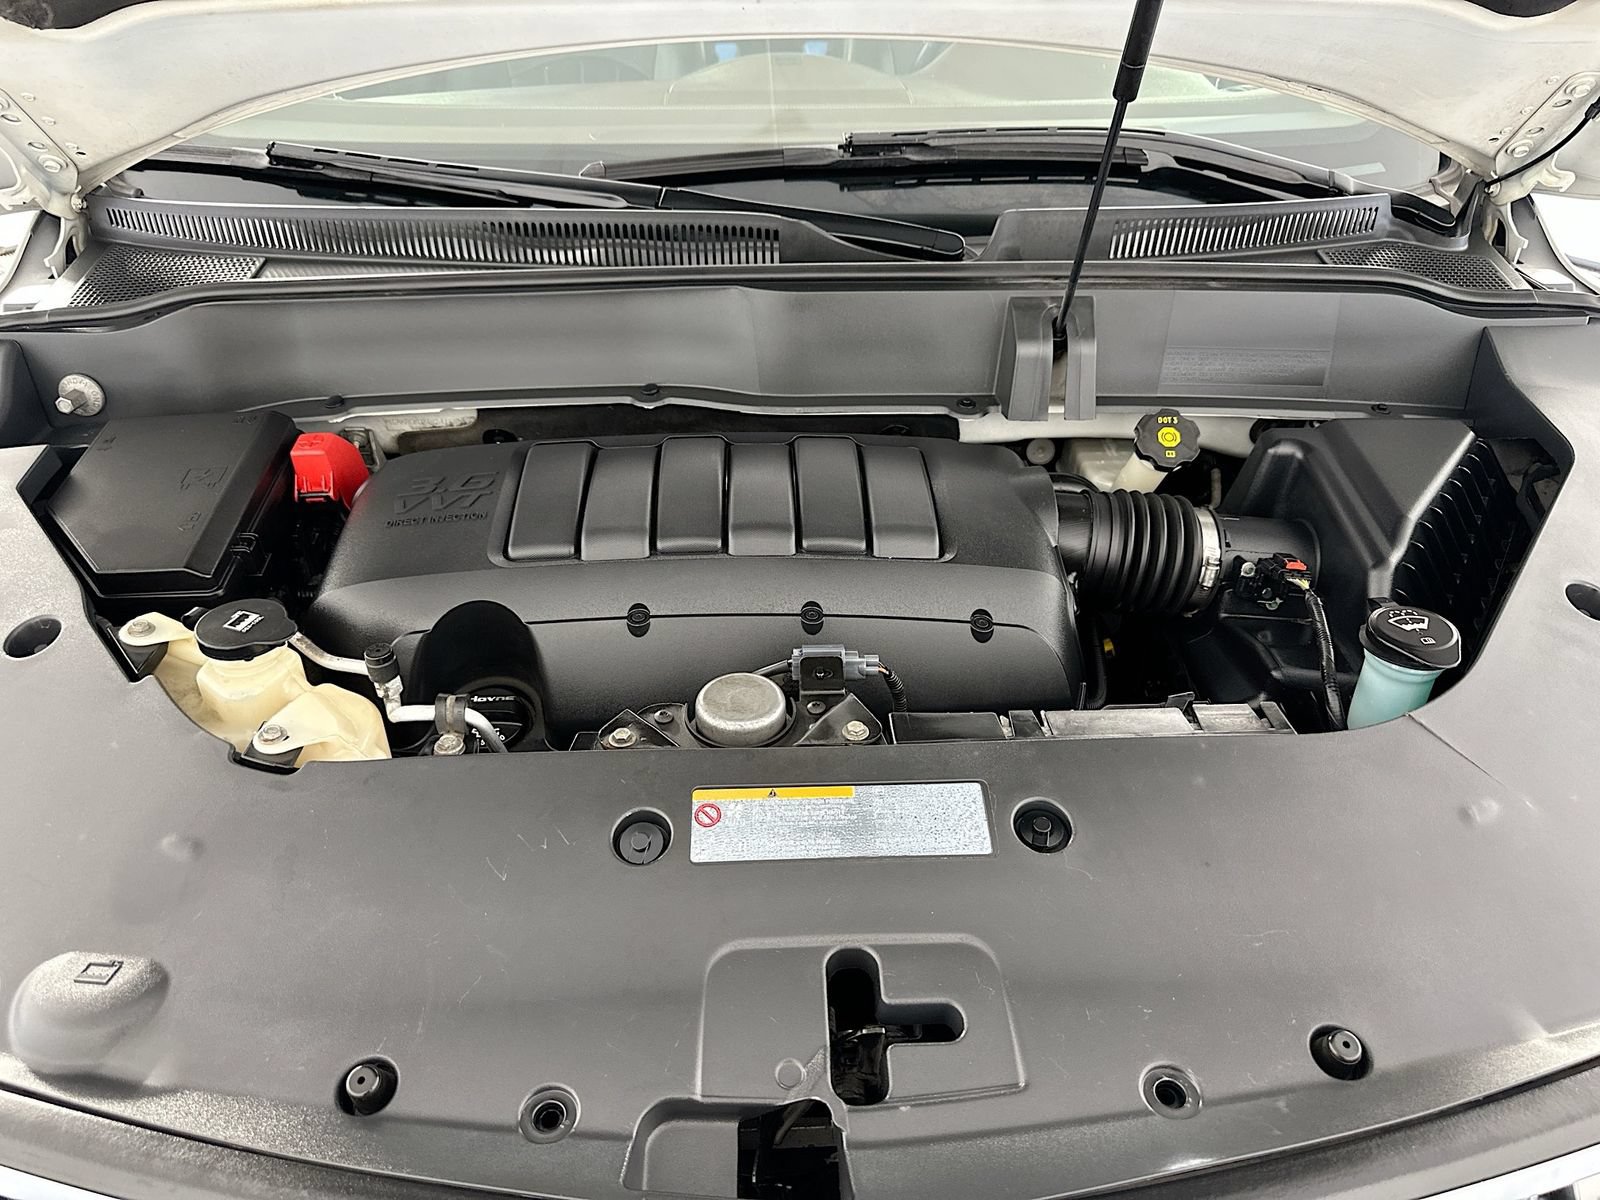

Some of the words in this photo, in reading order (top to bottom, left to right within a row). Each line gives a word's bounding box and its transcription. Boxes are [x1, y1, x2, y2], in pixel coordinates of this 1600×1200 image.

[1157, 416, 1172, 424] DOT
[394, 491, 494, 515] VVT
[385, 516, 428, 528] DIRECT
[429, 511, 488, 524] INJECTION
